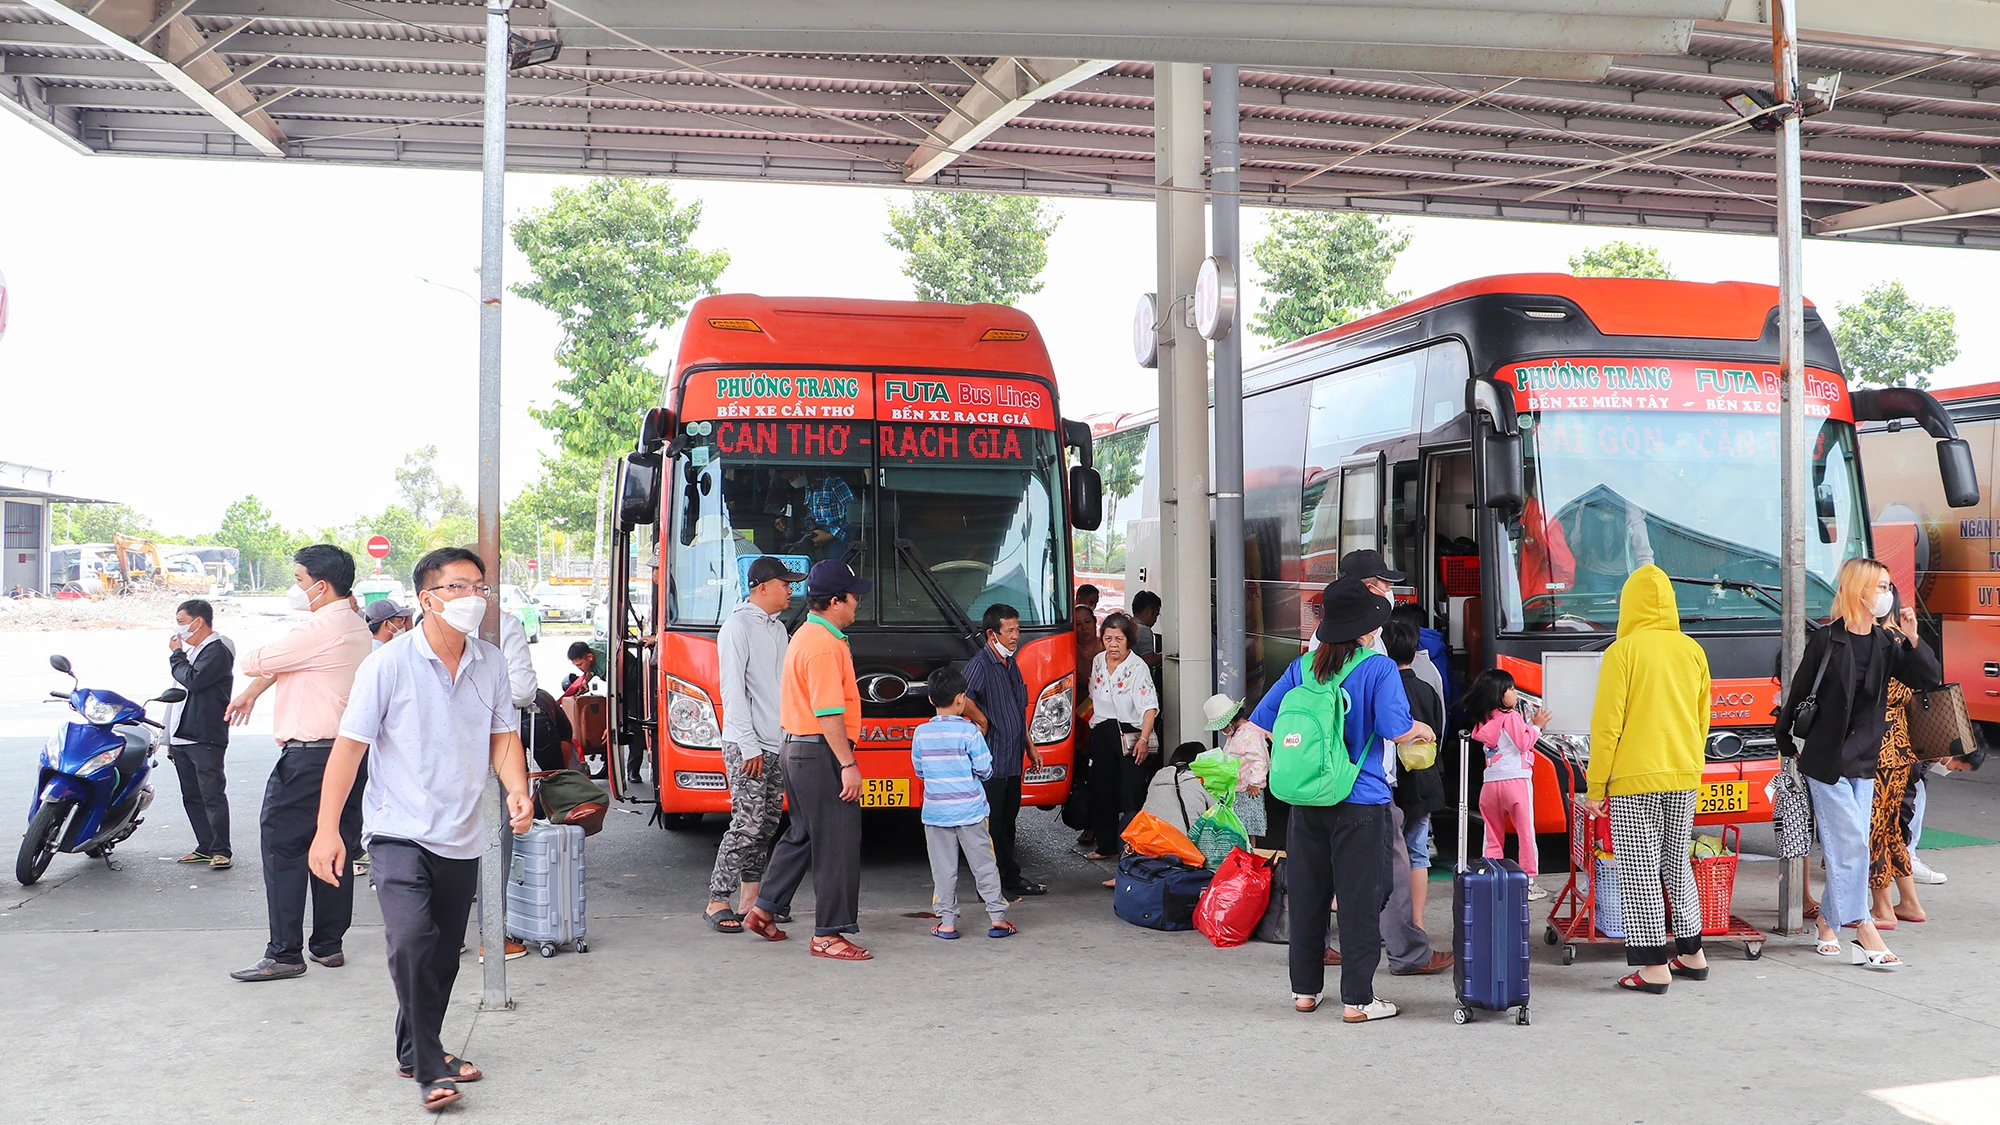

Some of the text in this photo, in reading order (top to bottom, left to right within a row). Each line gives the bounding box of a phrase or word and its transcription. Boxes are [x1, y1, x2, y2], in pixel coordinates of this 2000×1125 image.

[716, 372, 859, 399] PHƯƠNG TRANG
[1514, 360, 1672, 391] PHƯƠNG TRANG
[1695, 368, 1761, 395] FUTA
[885, 380, 1041, 409] FUTA Bus Lines
[1528, 392, 1562, 409] BẾN
[1566, 396, 1589, 409] XE
[1591, 391, 1633, 409] MIỀN
[1636, 394, 1669, 409] TÂY
[1706, 395, 1738, 411] BẾN
[1741, 400, 1763, 412] XE
[717, 400, 855, 418] BẾN XE CẦN THƠ
[892, 405, 1031, 425] BẾN XE RẠCH GIÁ
[786, 423, 850, 455] THƠ
[879, 425, 959, 463] RẠCH
[1960, 515, 1992, 539] NGÂN
[1978, 586, 1993, 607] UY
[1711, 692, 1754, 706] ACO
[1711, 710, 1751, 719] BIHOME
[869, 780, 894, 792] 51B
[1710, 784, 1734, 797] 51B
[860, 793, 904, 806] 131.67
[1701, 797, 1742, 812] 292.61
